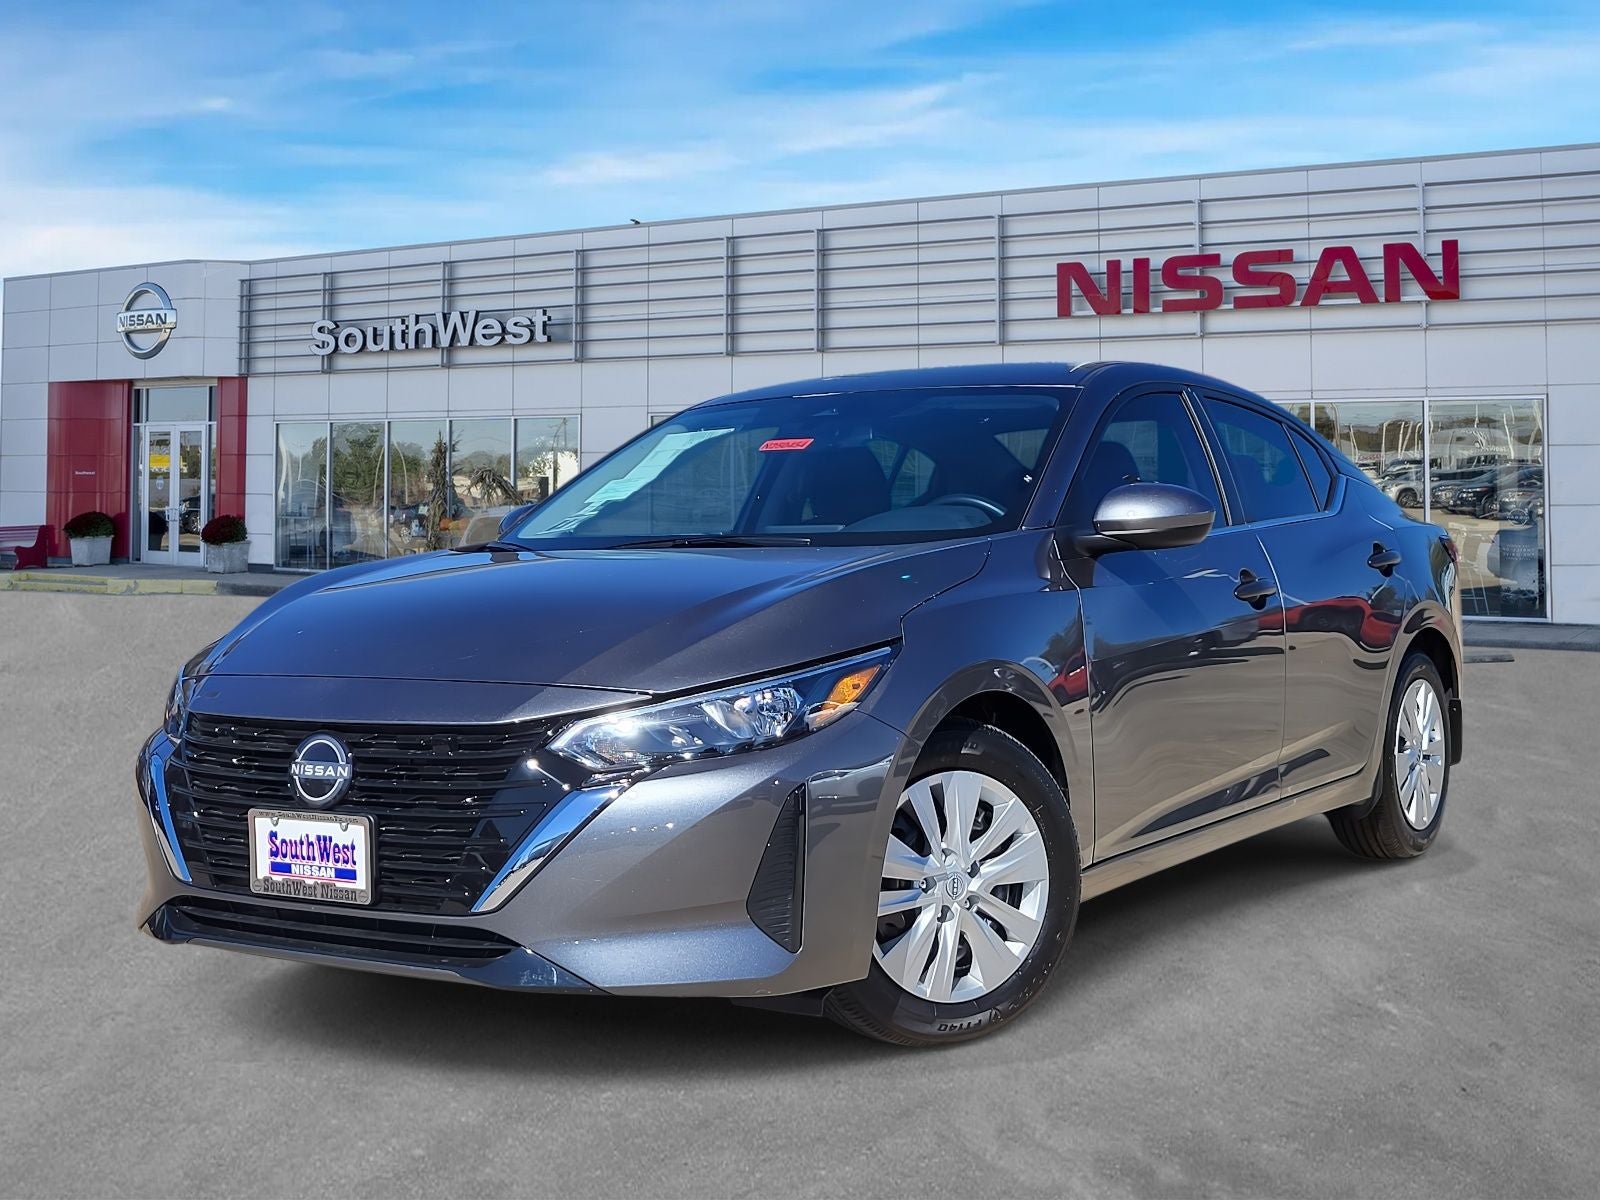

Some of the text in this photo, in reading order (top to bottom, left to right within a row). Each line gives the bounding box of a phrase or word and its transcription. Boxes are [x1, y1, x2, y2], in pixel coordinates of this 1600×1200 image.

[1056, 239, 1461, 318] NISSAN
[117, 312, 167, 329] NISSAN
[309, 308, 552, 356] SouthWest
[290, 763, 349, 778] NISSAN
[267, 830, 357, 866] SouthWest
[290, 863, 335, 878] NISSAN
[263, 876, 358, 902] SouthWest Nissan
